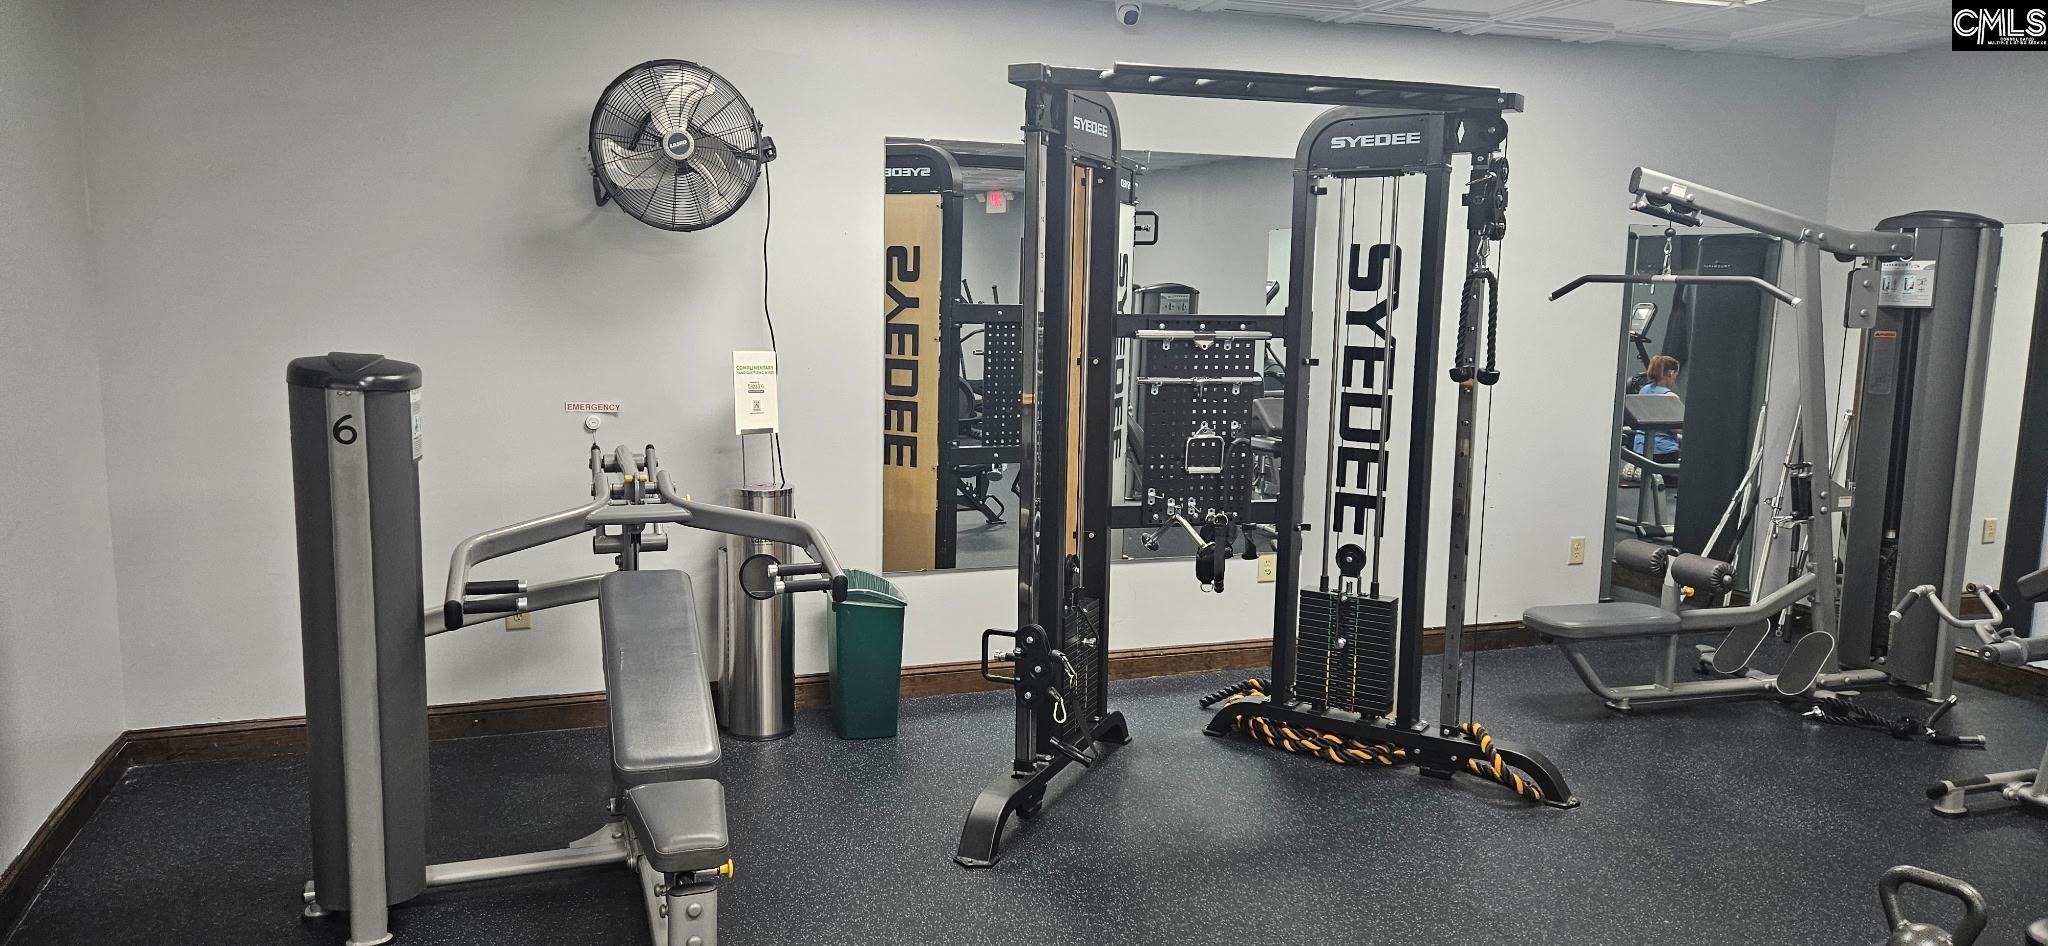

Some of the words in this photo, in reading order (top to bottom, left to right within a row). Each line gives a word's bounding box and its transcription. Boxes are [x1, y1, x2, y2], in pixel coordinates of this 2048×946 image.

[1073, 116, 1108, 138] SYEDEE
[1331, 132, 1421, 149] SYEDEE
[1333, 244, 1402, 538] SYEDEE
[567, 403, 621, 411] EMERGENCY
[332, 414, 358, 446] 6
